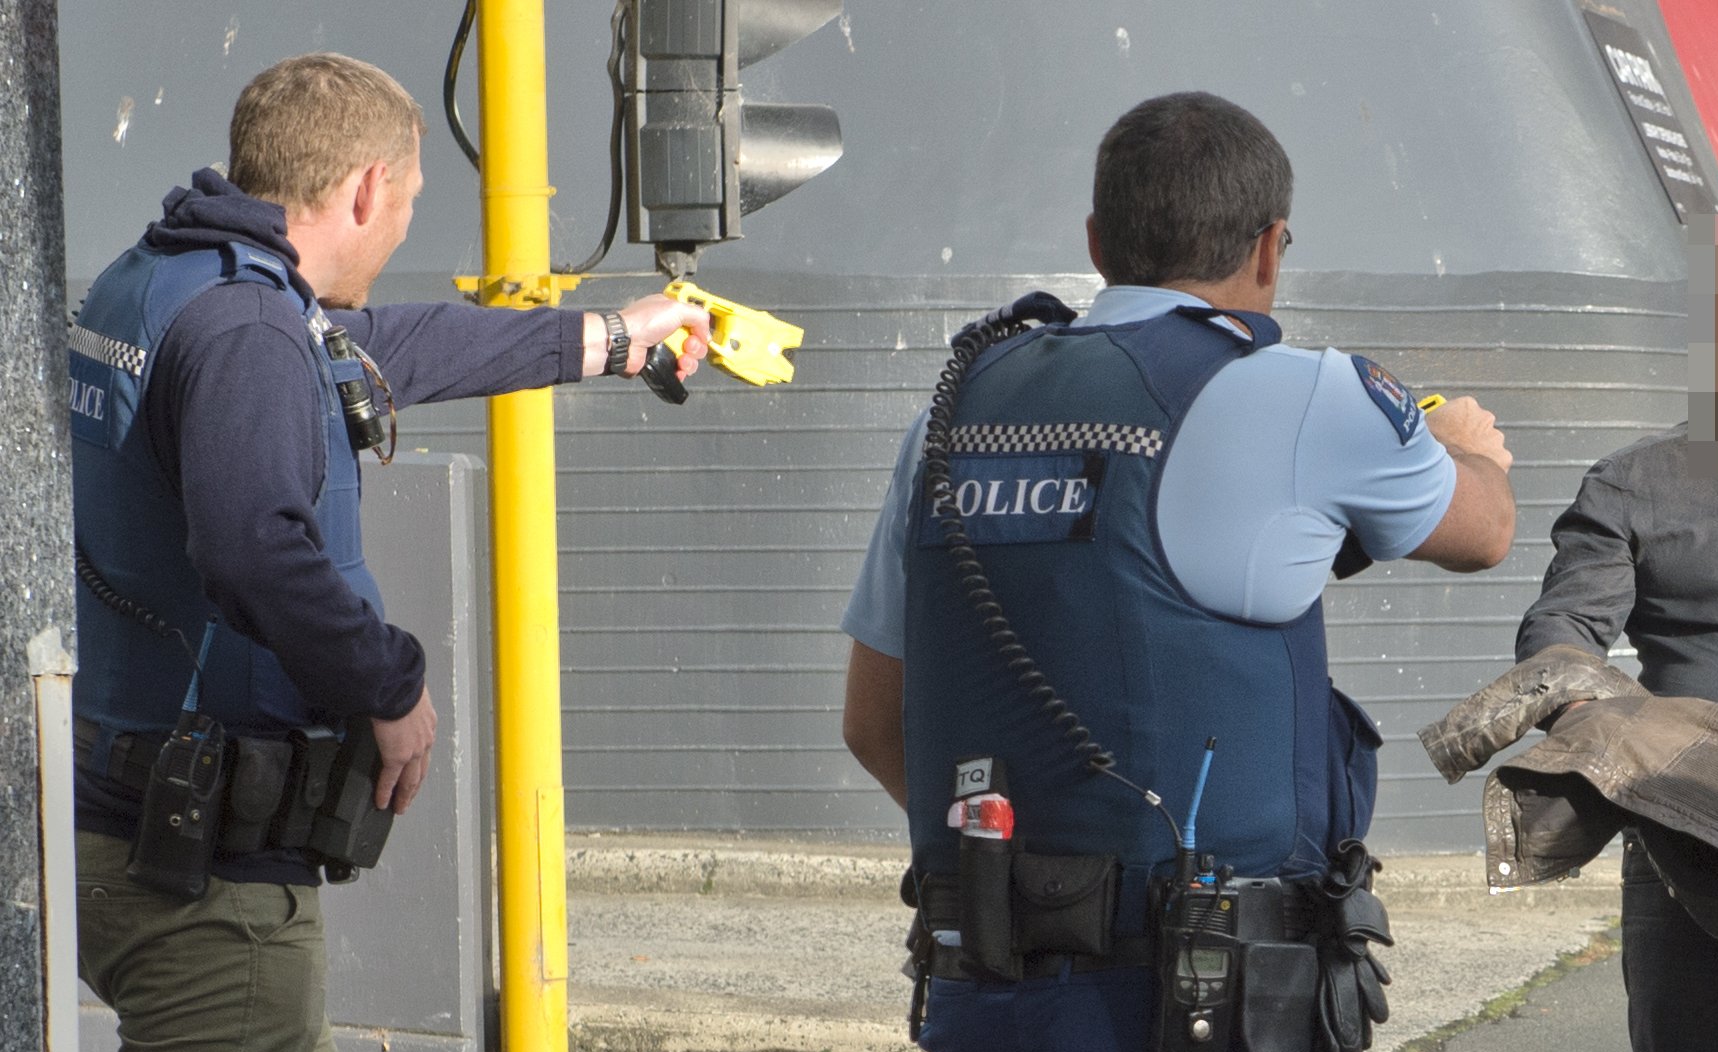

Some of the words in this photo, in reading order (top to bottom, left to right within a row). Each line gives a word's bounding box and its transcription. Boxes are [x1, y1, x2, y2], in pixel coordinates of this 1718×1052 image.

[68, 376, 105, 421] OLICE
[931, 477, 1088, 518] POLICE
[959, 768, 985, 786] TQ
